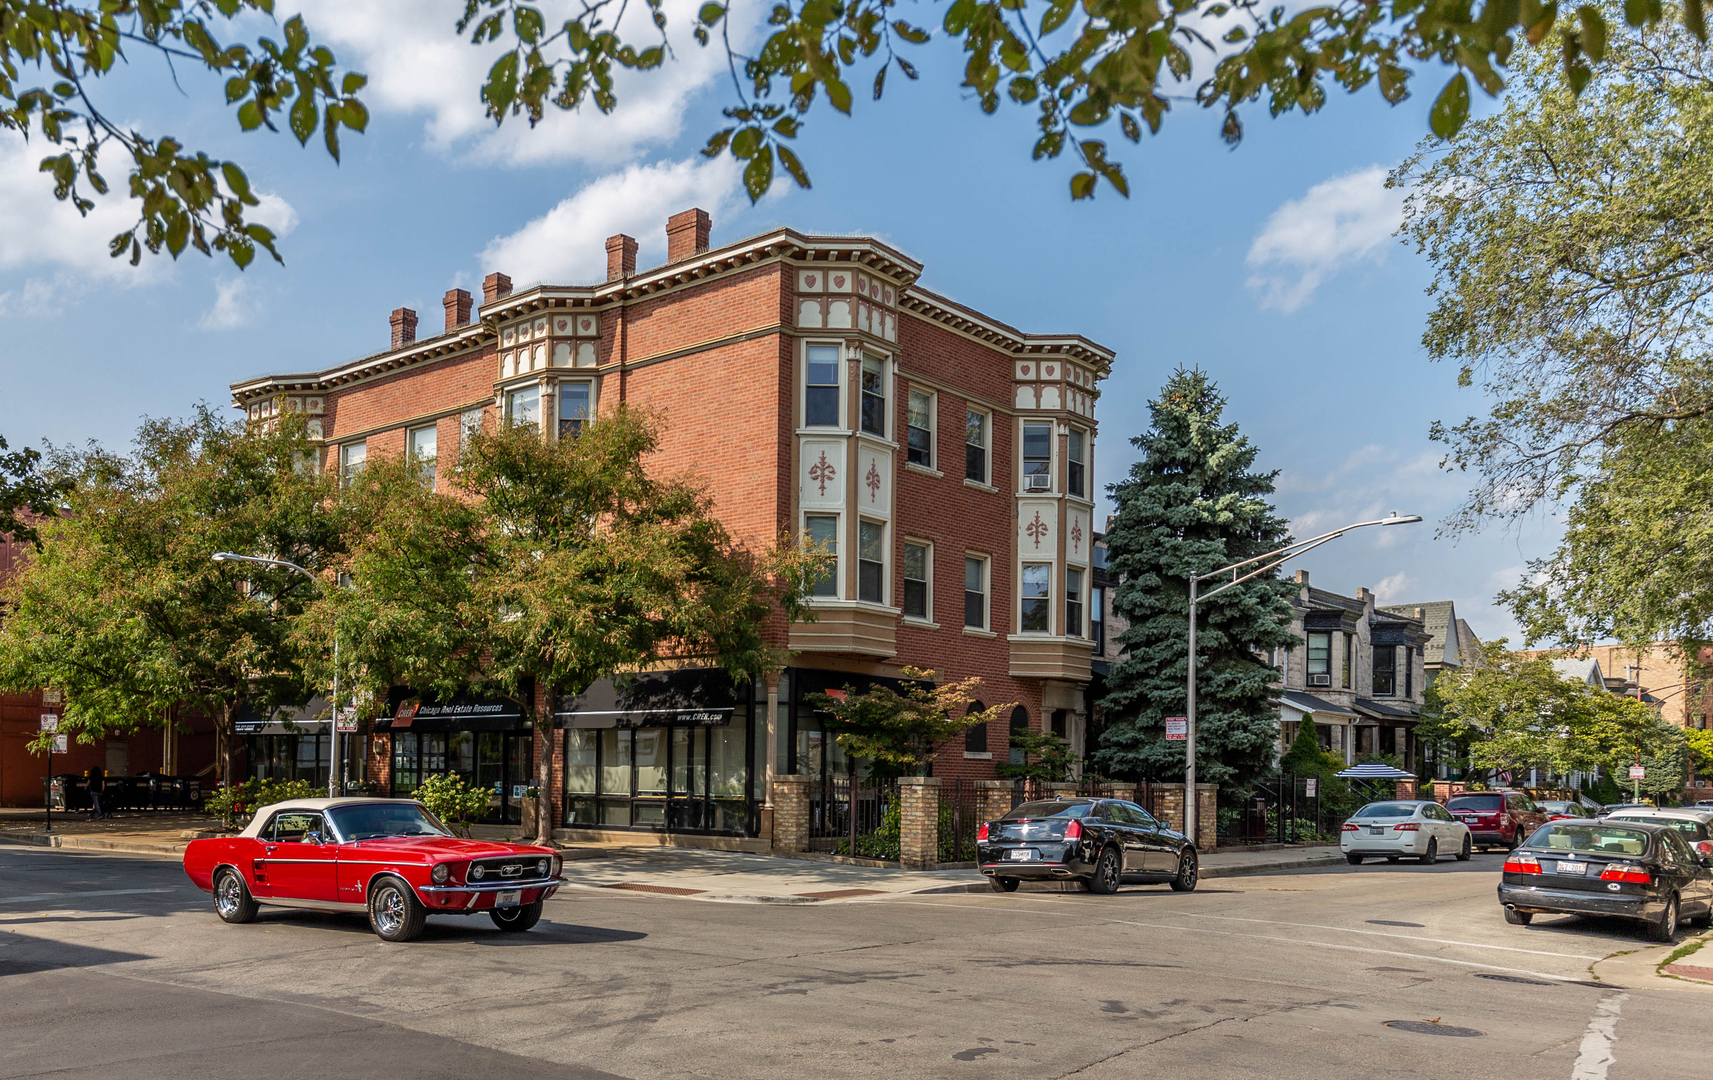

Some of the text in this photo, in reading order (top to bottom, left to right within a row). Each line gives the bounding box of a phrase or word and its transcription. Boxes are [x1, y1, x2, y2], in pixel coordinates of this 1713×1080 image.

[398, 709, 414, 717] CRER
[419, 704, 503, 715] Chicago Real Estate Resources
